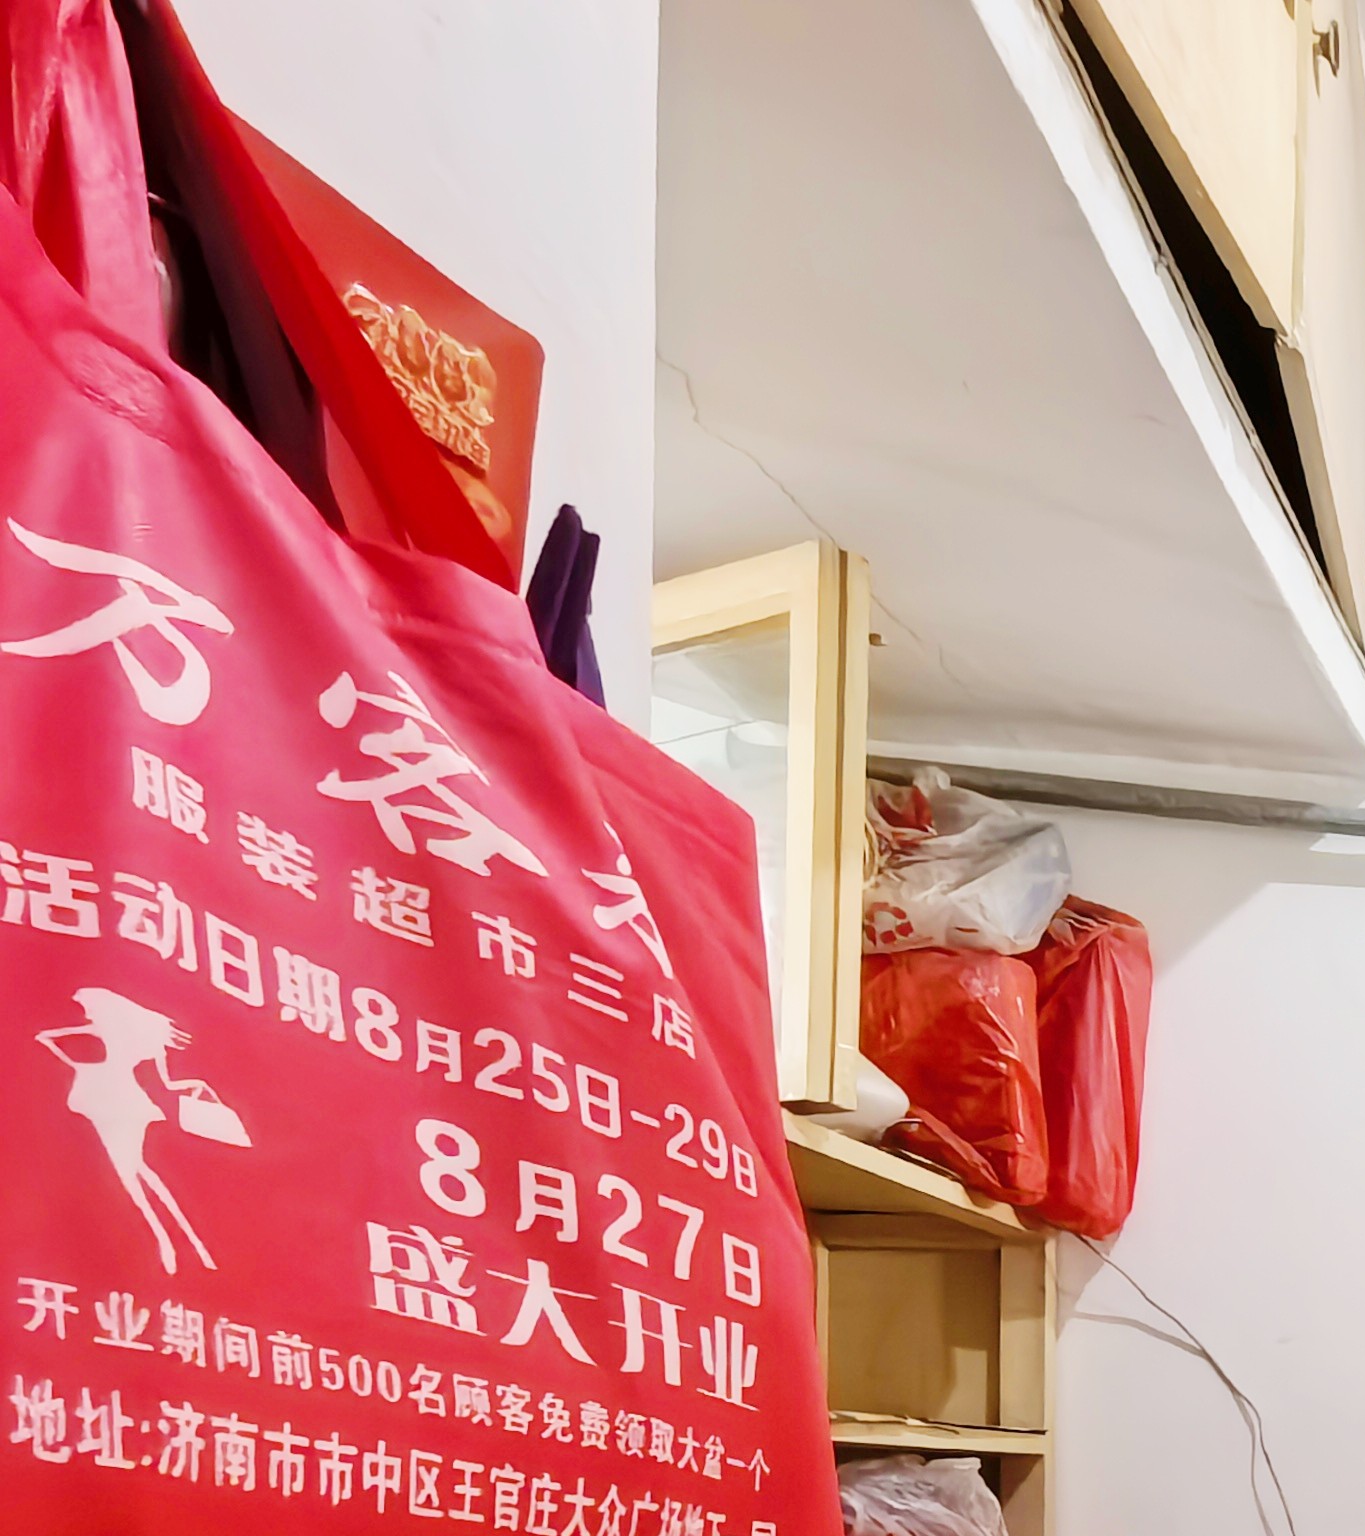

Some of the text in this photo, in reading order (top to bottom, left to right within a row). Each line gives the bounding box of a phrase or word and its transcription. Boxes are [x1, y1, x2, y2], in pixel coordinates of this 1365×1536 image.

[0, 840, 760, 1198] 活动日期8月25日-29日
[132, 745, 697, 1060] 服装超市三店
[366, 1220, 762, 1412] 盛大开业
[414, 1119, 763, 1307] 8月27日
